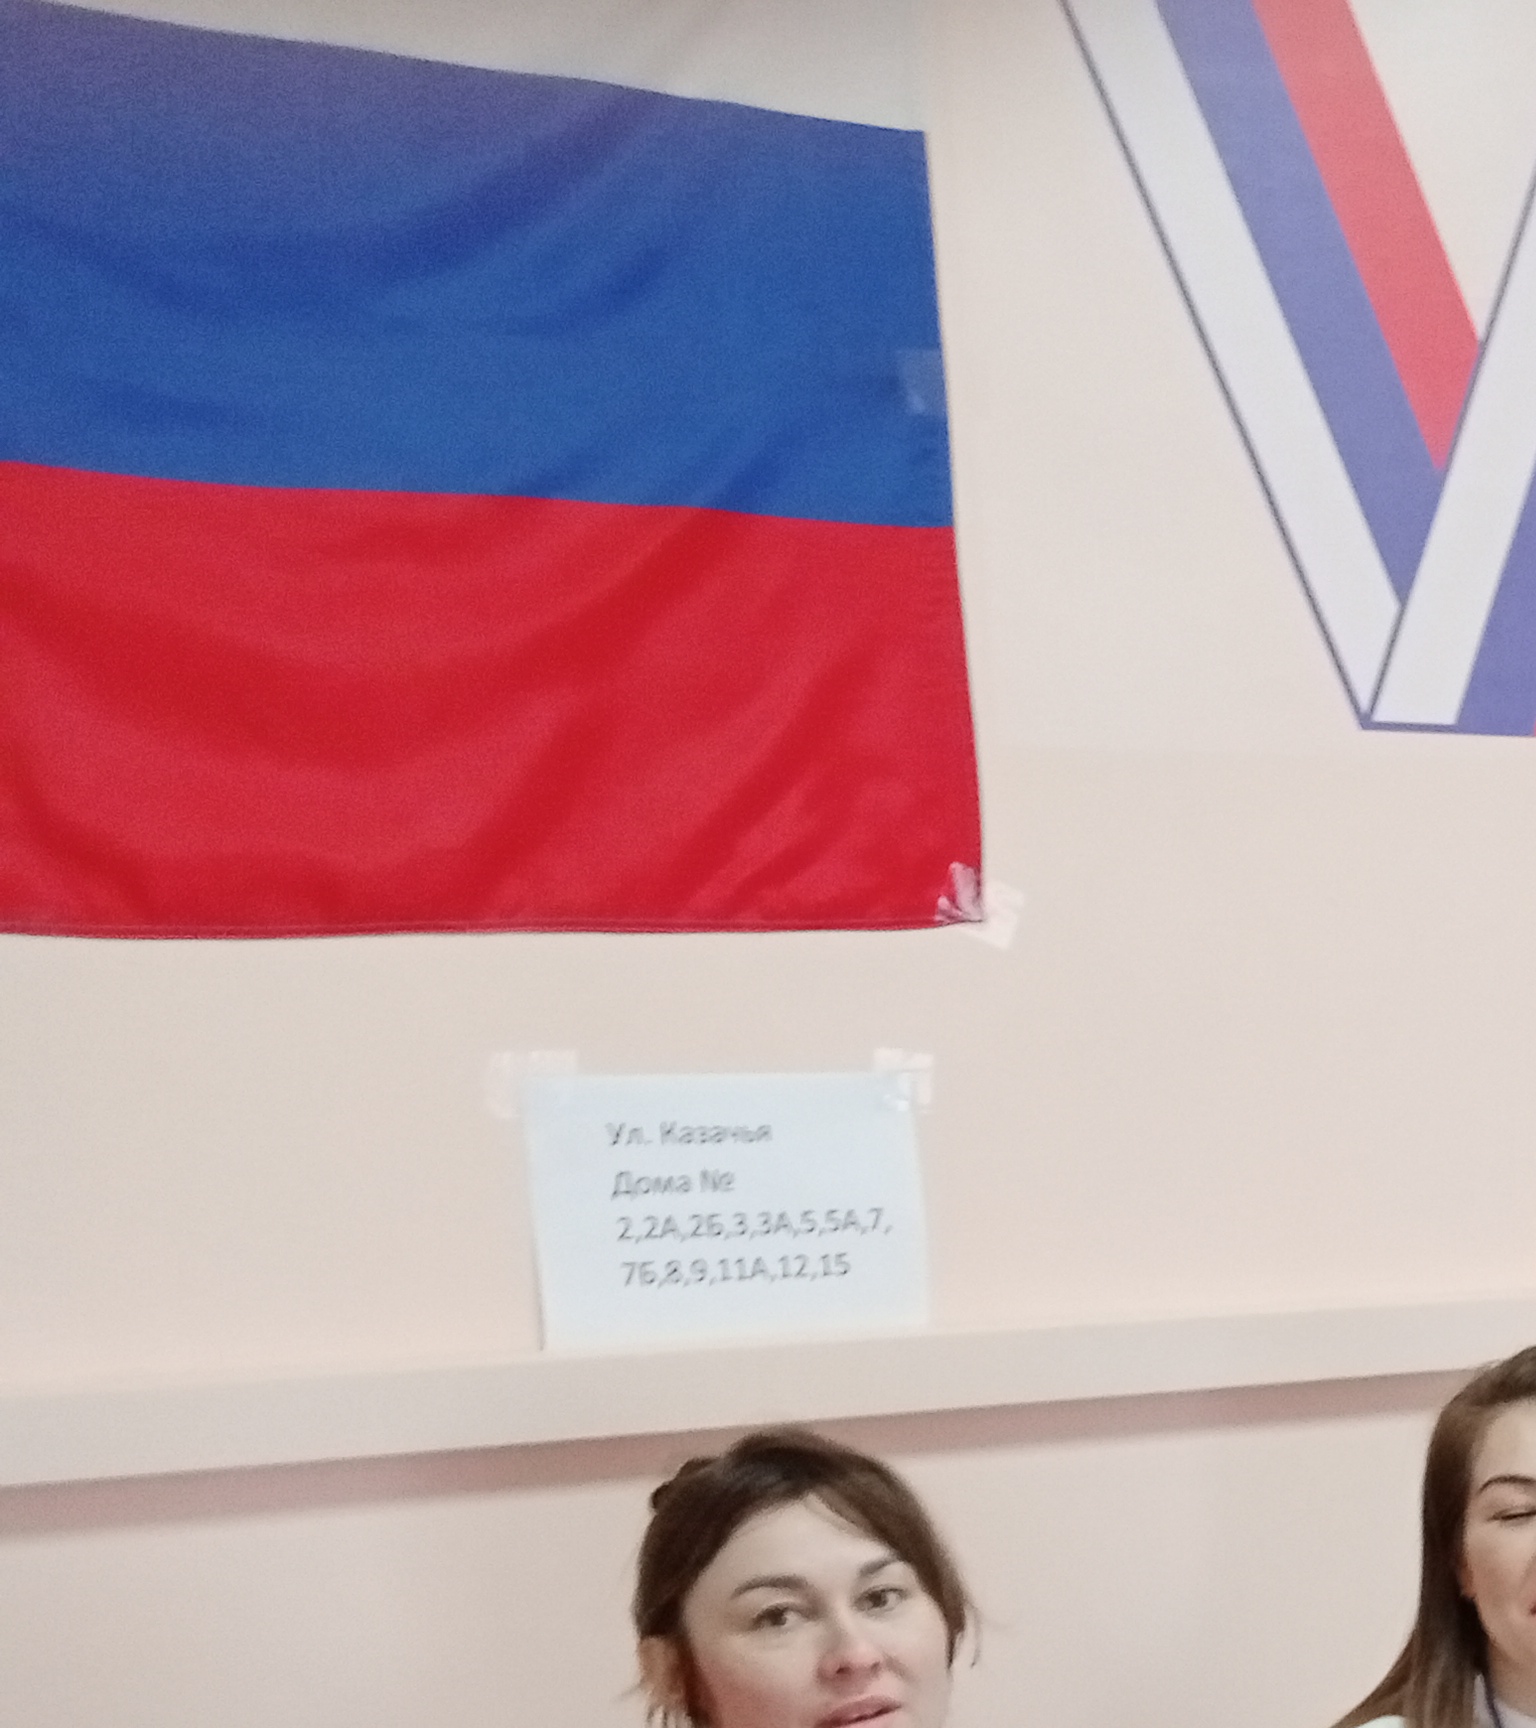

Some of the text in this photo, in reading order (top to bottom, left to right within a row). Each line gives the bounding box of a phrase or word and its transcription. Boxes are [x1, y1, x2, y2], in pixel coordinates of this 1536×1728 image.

[605, 1121, 773, 1147] Ул. Казачья
[611, 1169, 736, 1201] Дома №
